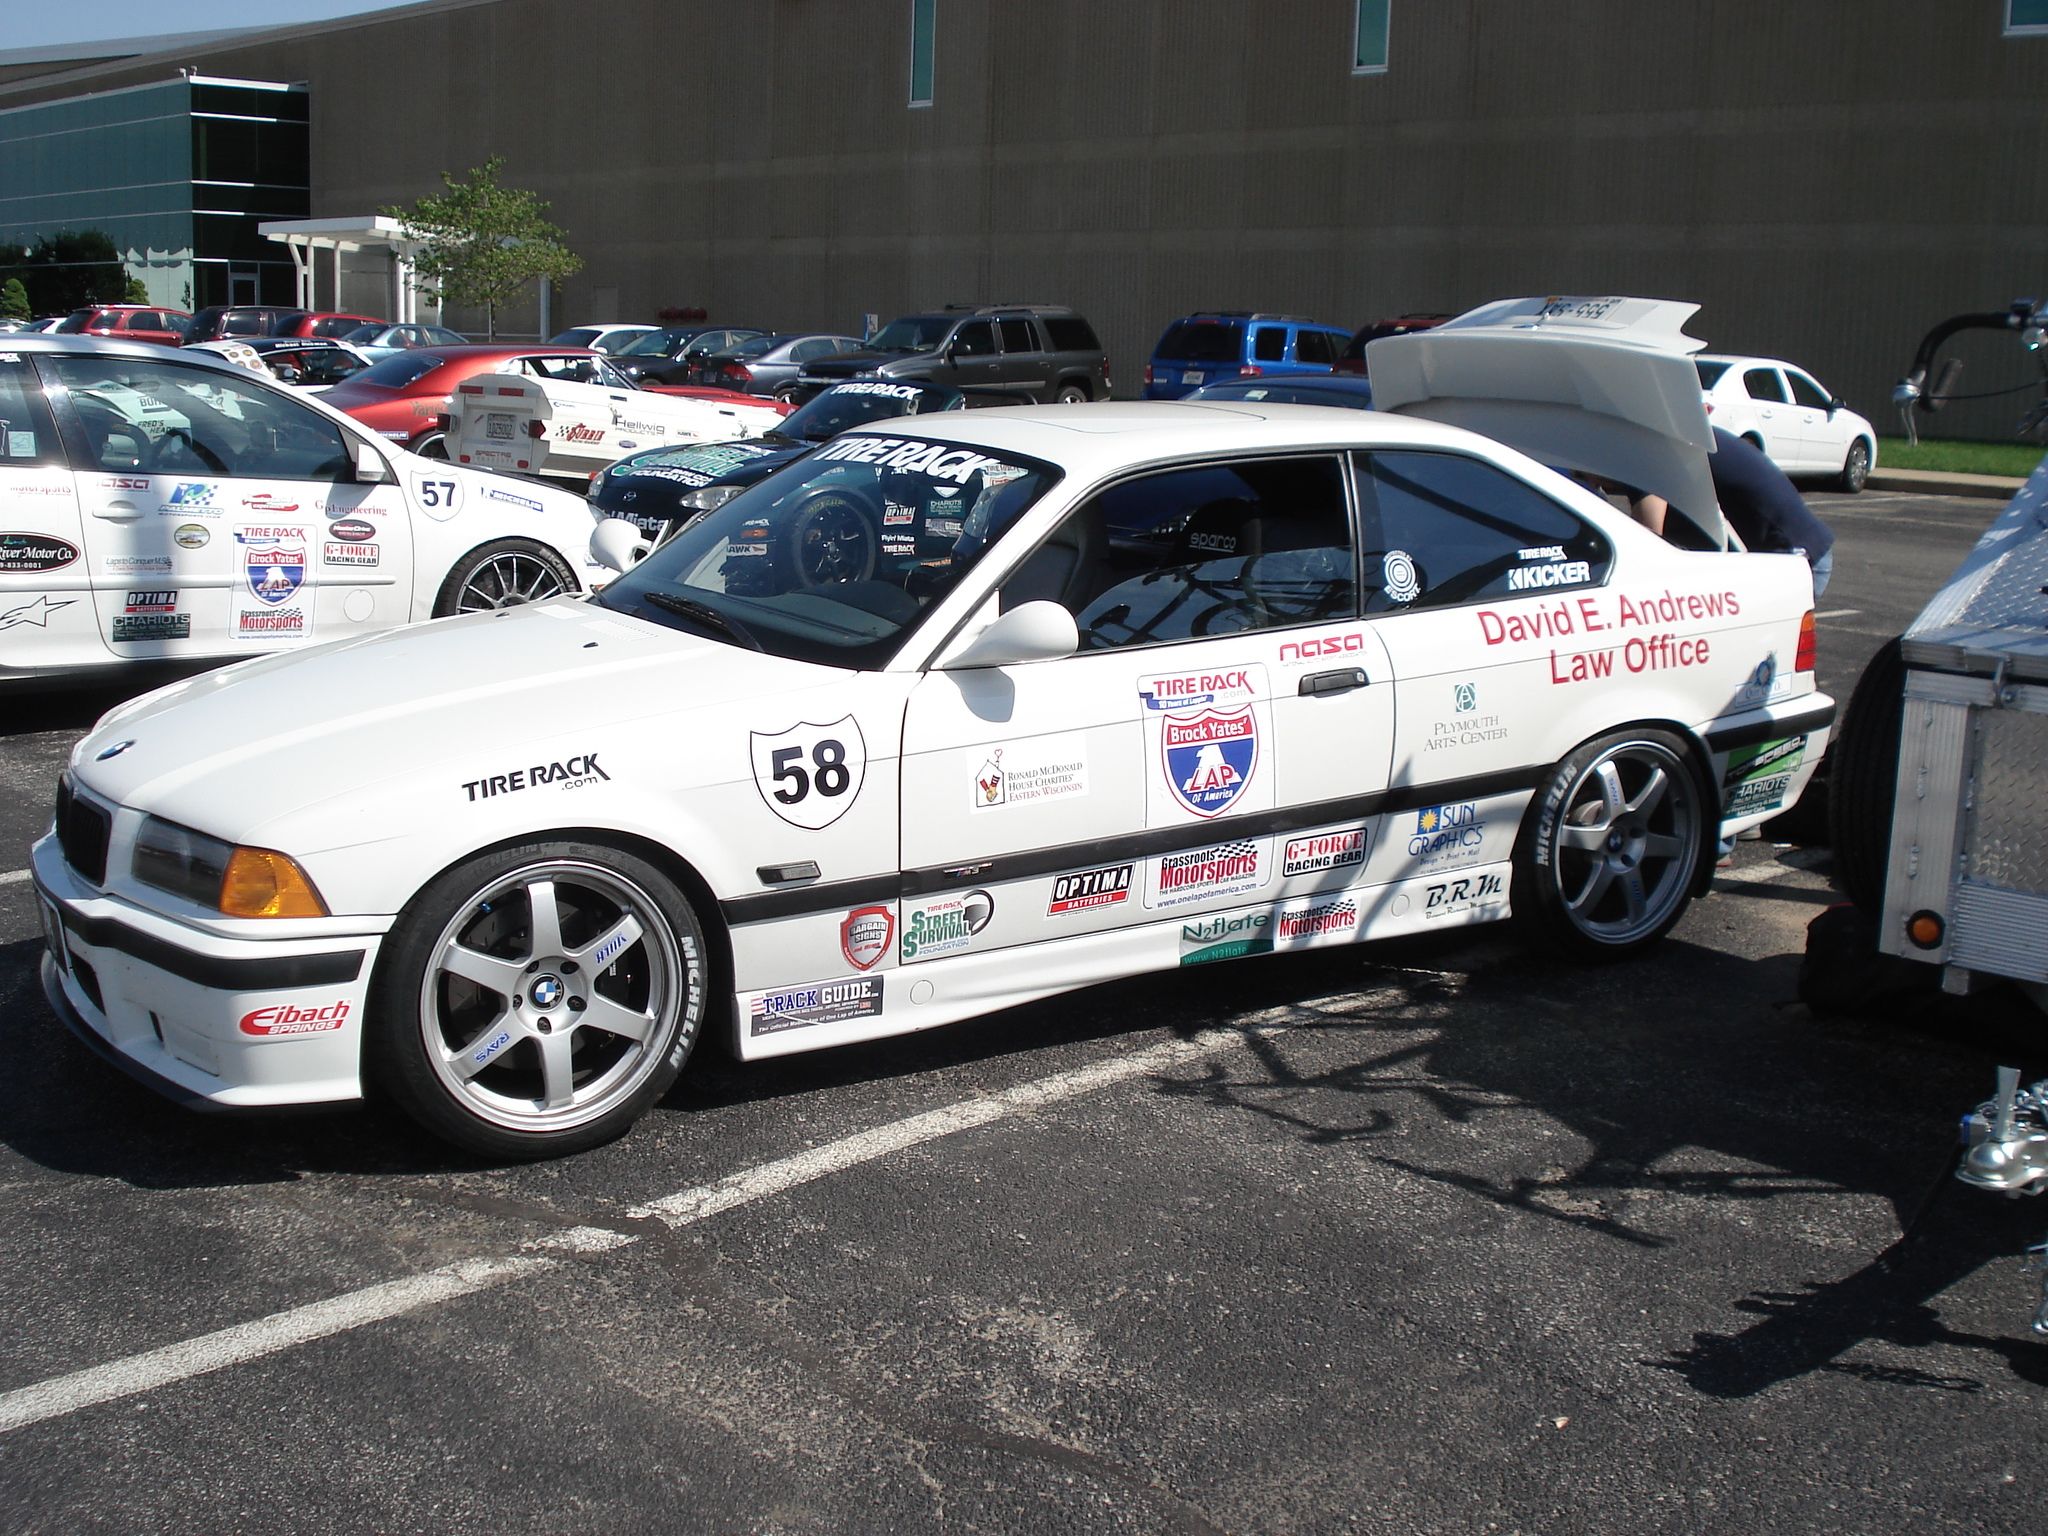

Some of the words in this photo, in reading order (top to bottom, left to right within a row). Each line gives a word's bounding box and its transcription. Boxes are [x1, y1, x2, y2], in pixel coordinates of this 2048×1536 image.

[615, 420, 665, 434] Hellwig
[422, 481, 455, 507] 57
[243, 527, 271, 537] TIRE
[273, 528, 307, 542] RACK
[1190, 532, 1236, 551] sparco
[22, 546, 57, 560] Motor
[57, 547, 73, 561] Co.
[250, 554, 276, 564] Brock
[276, 554, 301, 564] Yates'
[326, 545, 377, 557] G-FORCE
[1518, 547, 1541, 560] TIRE
[1540, 546, 1568, 560] RACK
[260, 579, 290, 590] LAP
[1523, 561, 1591, 588] KICKER
[128, 592, 176, 605] OPTIMA
[113, 614, 190, 627] CHARIOTS
[240, 615, 303, 631] Motorsports
[1476, 601, 1574, 645] David
[1577, 599, 1612, 632] E.
[1619, 590, 1740, 628] Andrews
[1280, 634, 1363, 661] nasa
[1550, 648, 1614, 685] Law
[1625, 634, 1710, 673] Office
[1153, 678, 1197, 697] TIRE
[1200, 671, 1255, 694] RACK
[1170, 721, 1208, 744] Brock
[1209, 717, 1248, 738] Yates'
[1423, 738, 1457, 752] ARTS
[1460, 728, 1508, 745] CENTER
[461, 771, 526, 802] TIRE
[529, 753, 612, 787] RACK
[561, 776, 598, 791] .com
[772, 739, 850, 804] 58
[1188, 764, 1234, 792] LAP
[1203, 788, 1234, 802] America
[1442, 803, 1475, 828] SUN
[1536, 762, 1579, 867] MICHELIN
[1287, 832, 1364, 861] G-FORCE
[1408, 826, 1484, 856] GRAPHICS
[1160, 852, 1258, 890] Motorsports
[1162, 850, 1216, 870] Grassroots
[1286, 857, 1330, 873] RACING
[1333, 850, 1362, 866] GEAR
[1056, 868, 1129, 899] OPTIMA
[1159, 888, 1169, 896] THE
[1196, 880, 1215, 890] SPORTS
[927, 903, 943, 912] TIRE
[943, 900, 964, 911] RACK
[1067, 894, 1114, 909] BATTERIES
[1157, 884, 1257, 908] www.onelapofamerica.com
[911, 909, 964, 933] STREET
[1280, 908, 1357, 938] Motorsports
[1281, 905, 1324, 921] Grassroots
[851, 921, 887, 937] BARGAIN
[855, 930, 882, 943] SIGNS
[903, 921, 970, 958] SURVIVAL
[918, 940, 970, 956] FOUNDATION
[668, 936, 700, 1069] MICHELIN
[763, 990, 817, 1015] TRACK
[822, 981, 872, 1005] GUIDE
[239, 1001, 350, 1036] Eibach
[267, 1020, 338, 1036] SPRINGS
[475, 1032, 511, 1063] RAYS
